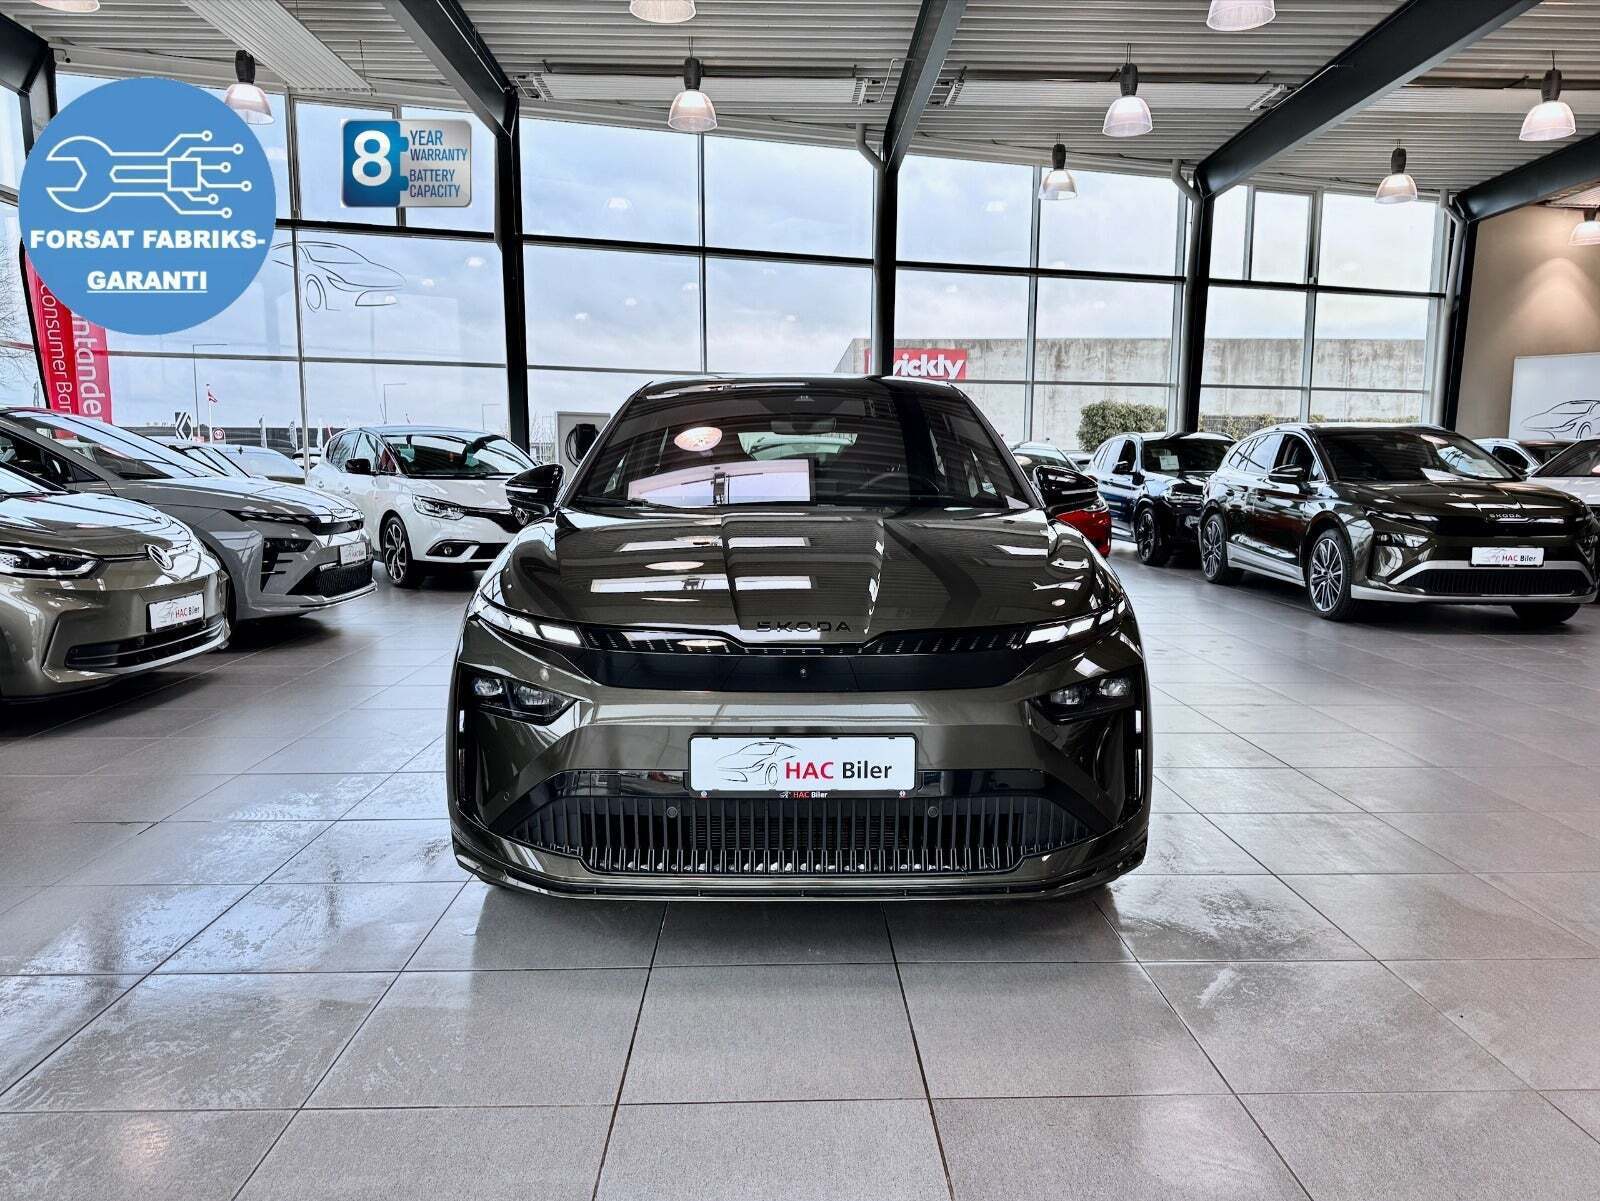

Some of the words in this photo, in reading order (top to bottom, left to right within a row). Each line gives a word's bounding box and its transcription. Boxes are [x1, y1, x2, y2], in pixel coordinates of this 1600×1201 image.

[869, 353, 965, 380] vickly
[785, 762, 834, 780] HAC
[842, 760, 893, 779] Biler
[793, 791, 810, 799] HAC
[811, 791, 829, 799] Biler
